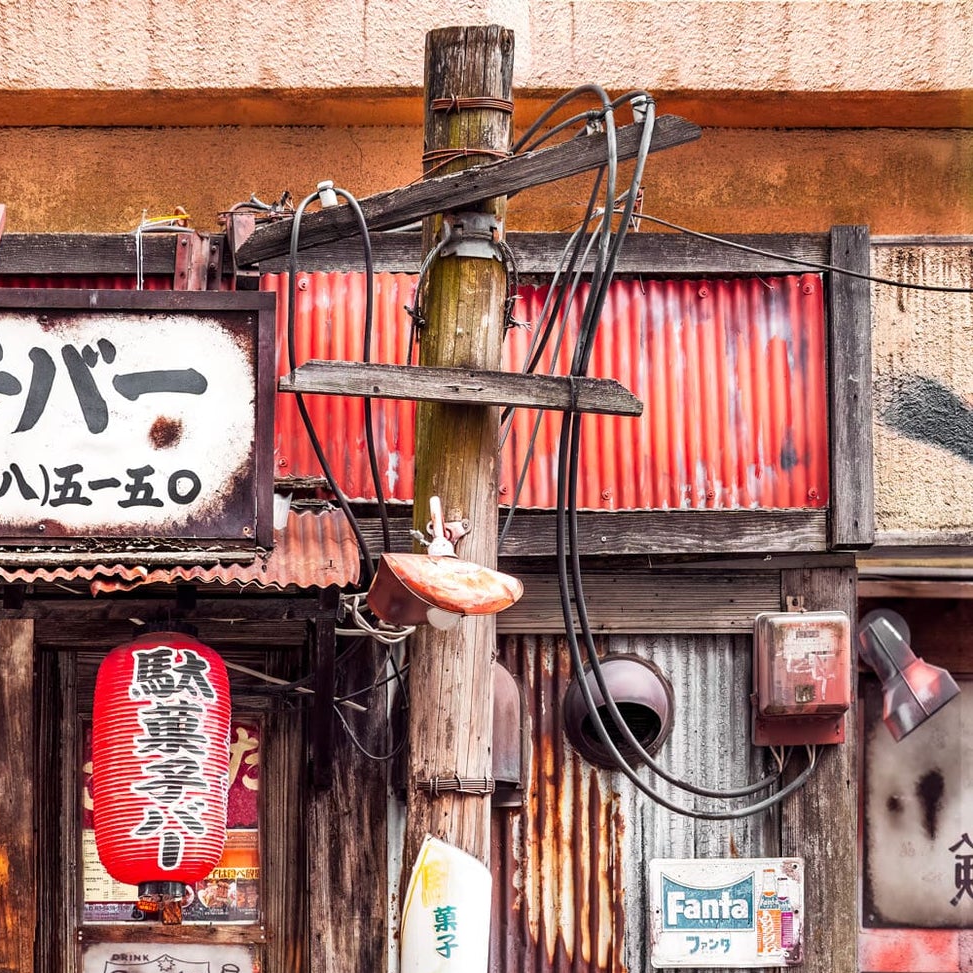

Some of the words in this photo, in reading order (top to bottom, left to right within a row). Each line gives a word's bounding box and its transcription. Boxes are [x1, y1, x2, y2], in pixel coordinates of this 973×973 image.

[131, 648, 216, 868] 駄菓子バー
[667, 888, 749, 926] Fanta
[110, 953, 149, 962] DRINK
[685, 935, 732, 955] ファンタ
